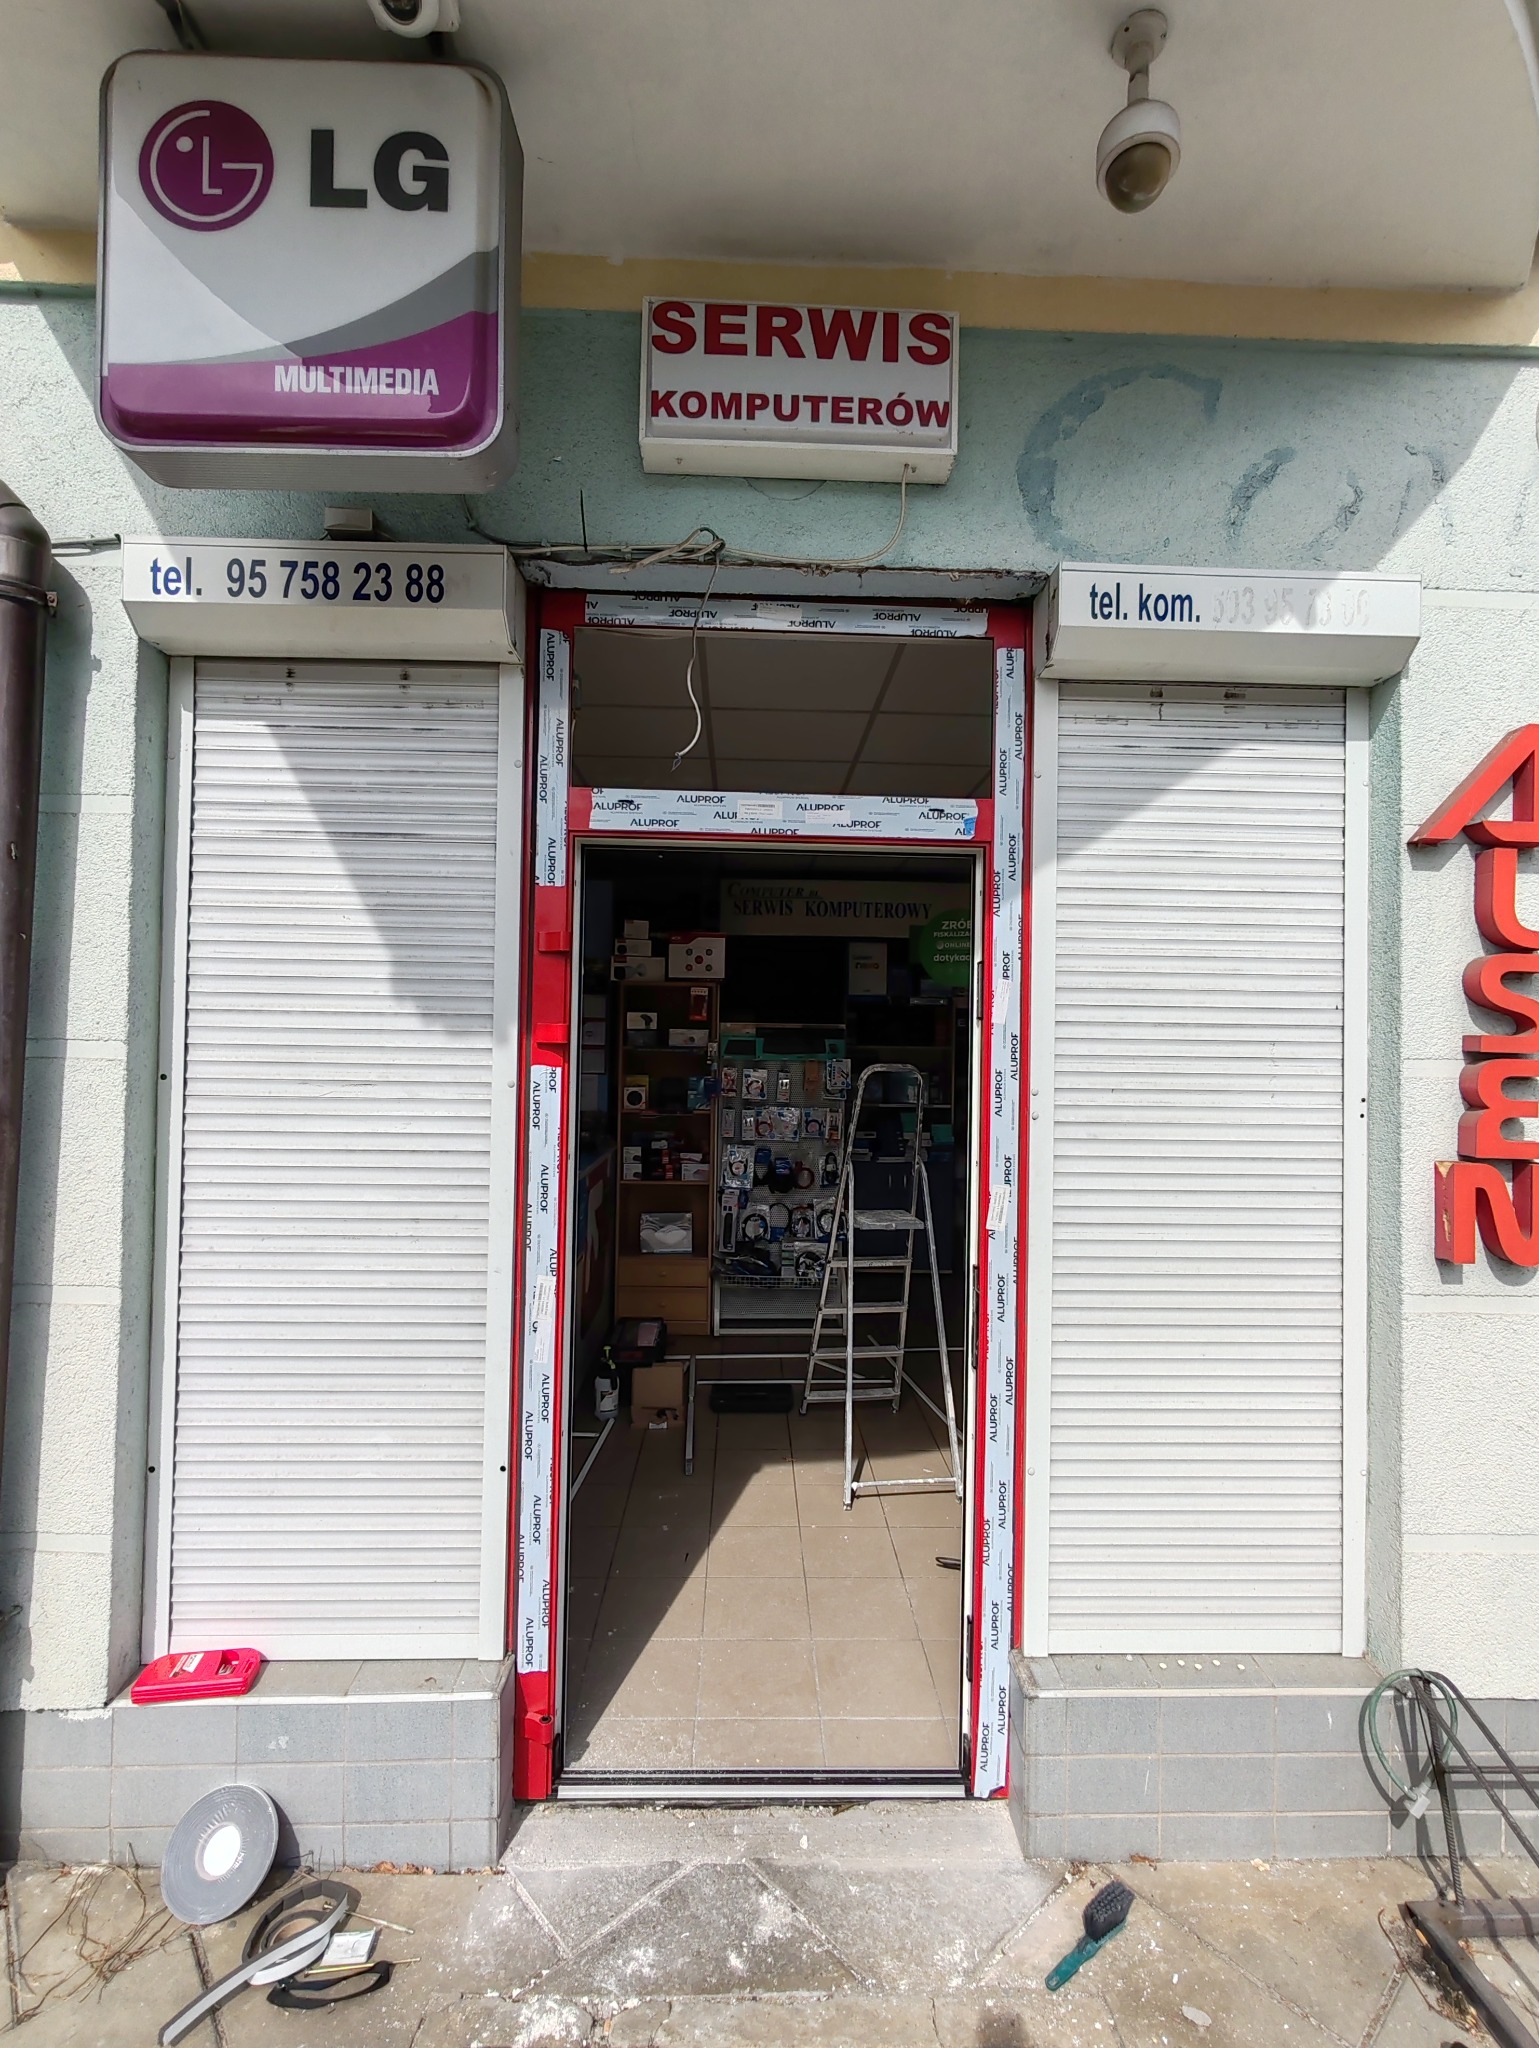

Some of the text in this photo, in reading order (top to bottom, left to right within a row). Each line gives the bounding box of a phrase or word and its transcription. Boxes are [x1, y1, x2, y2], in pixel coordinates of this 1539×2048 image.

[309, 128, 450, 213] LG
[651, 301, 950, 365] SERWIS
[274, 365, 439, 396] MULTIMEDIA
[650, 390, 950, 428] KOMPUTERÓW
[150, 556, 445, 603] tel. 95 758 23 88
[1090, 582, 1128, 621] tel.
[1138, 583, 1201, 623] kom.
[587, 616, 635, 626] ALUPROF
[787, 619, 836, 629] ALUPROF
[872, 612, 921, 622] ALUPROF
[911, 629, 958, 638] ALUPROF
[546, 632, 556, 682] ALUPROF
[555, 718, 564, 767] ALUPROF
[1014, 712, 1024, 760] ALUPROF
[539, 755, 548, 804] ALUPROF
[999, 747, 1008, 797] ALUPROF
[593, 802, 643, 812] ALUPROF
[630, 818, 680, 828] ALUPROF
[676, 794, 726, 804] ALUPROF
[796, 803, 846, 812] ALUPROF
[882, 796, 929, 804] ALUPROF
[919, 811, 967, 821] ALUPROF
[547, 837, 557, 886] ALUPROF
[1008, 833, 1017, 881] ALUPROF
[733, 899, 932, 919] SERWIS KOMPUTEROWY
[993, 869, 1001, 918] ALUPROF
[1011, 1032, 1019, 1081] ALUPROF
[532, 1081, 541, 1131] ALUPROF
[994, 1068, 1003, 1117] ALUPROF
[540, 1164, 549, 1214] ALUPROF
[997, 1273, 1006, 1323] ALUPROF
[541, 1373, 550, 1423] ALUPROF
[1006, 1356, 1014, 1405] ALUPROF
[524, 1411, 533, 1461] ALUPROF
[989, 1393, 998, 1442] ALUPROF
[533, 1494, 542, 1545] ALUPROF
[998, 1480, 1007, 1529] ALUPROF
[982, 1518, 991, 1566] ALUPROF
[542, 1579, 550, 1628] ALUPROF
[991, 1600, 1000, 1650] ALUPROF
[525, 1617, 534, 1668] ALUPROF
[998, 1684, 1007, 1735] ALUPROF
[980, 1722, 990, 1772] ALUPROF
